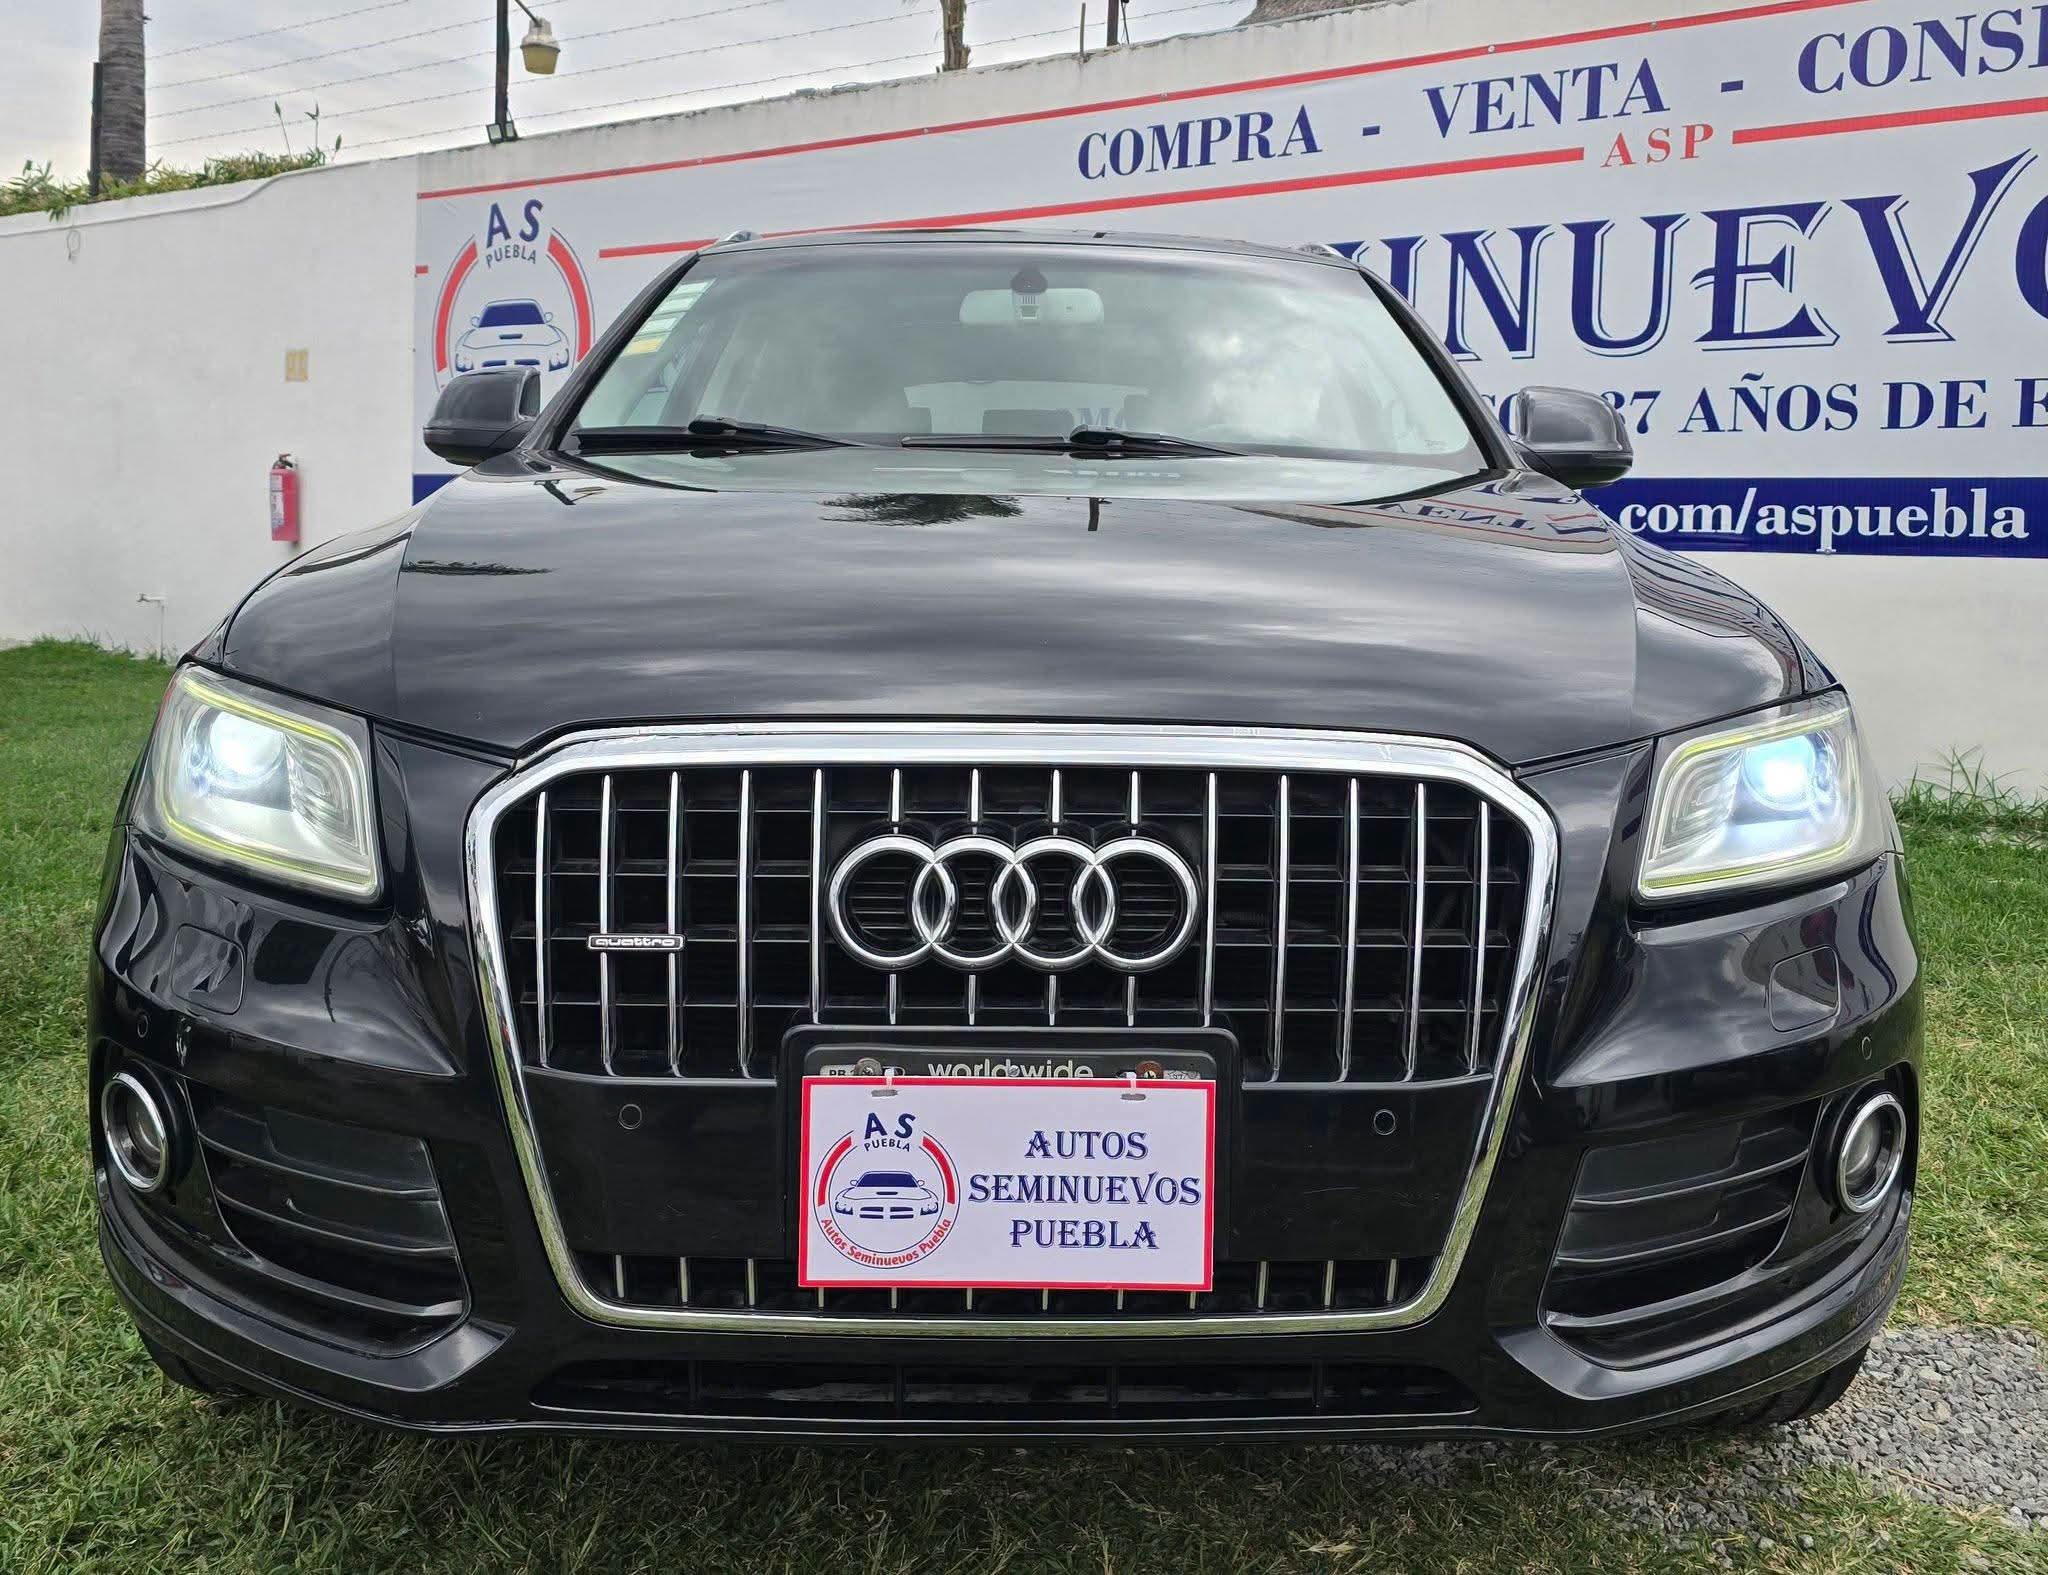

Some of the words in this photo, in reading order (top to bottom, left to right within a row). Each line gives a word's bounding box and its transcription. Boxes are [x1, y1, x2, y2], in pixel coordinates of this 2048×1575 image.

[1078, 104, 1322, 180] COMPRA
[1423, 57, 1670, 139] VENTA
[486, 244, 536, 268] PUEBLA
[1678, 373, 1858, 434] AÑOS
[1880, 379, 1988, 430] DE
[1618, 488, 2030, 554] com/aspuebla
[595, 937, 676, 947] quattro
[927, 1058, 1094, 1078] worldwide
[864, 1138, 910, 1152] PUEBLA
[1025, 1130, 1149, 1160] AUTOS
[968, 1171, 1202, 1205] SEMINUEVOS
[821, 1219, 848, 1250] Autos
[847, 1245, 919, 1266] Seminuevos
[918, 1218, 952, 1254] Puebla
[1009, 1219, 1159, 1250] PUEBLA
